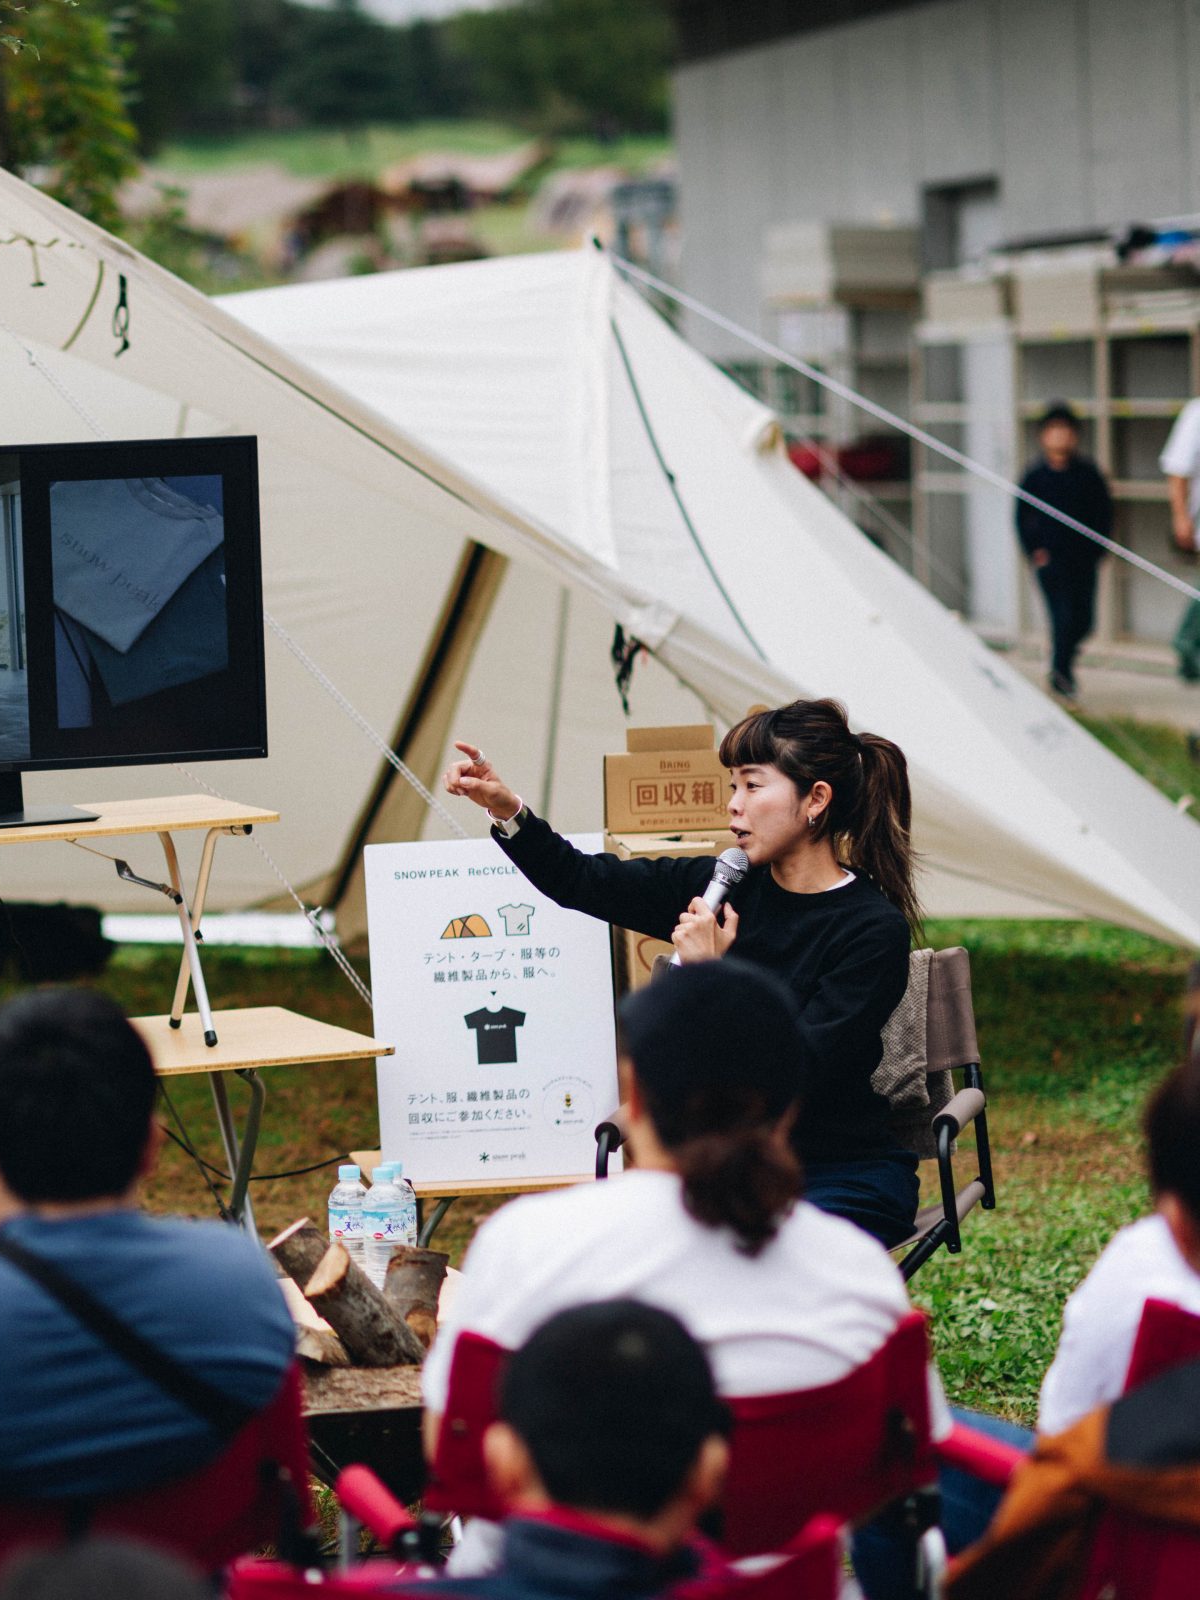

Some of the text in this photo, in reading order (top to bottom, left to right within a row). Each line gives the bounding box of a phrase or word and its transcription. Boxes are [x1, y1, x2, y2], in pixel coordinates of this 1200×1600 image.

[636, 781, 715, 806] 回収箱
[394, 869, 427, 881] SNOW
[429, 868, 460, 879] PEAK
